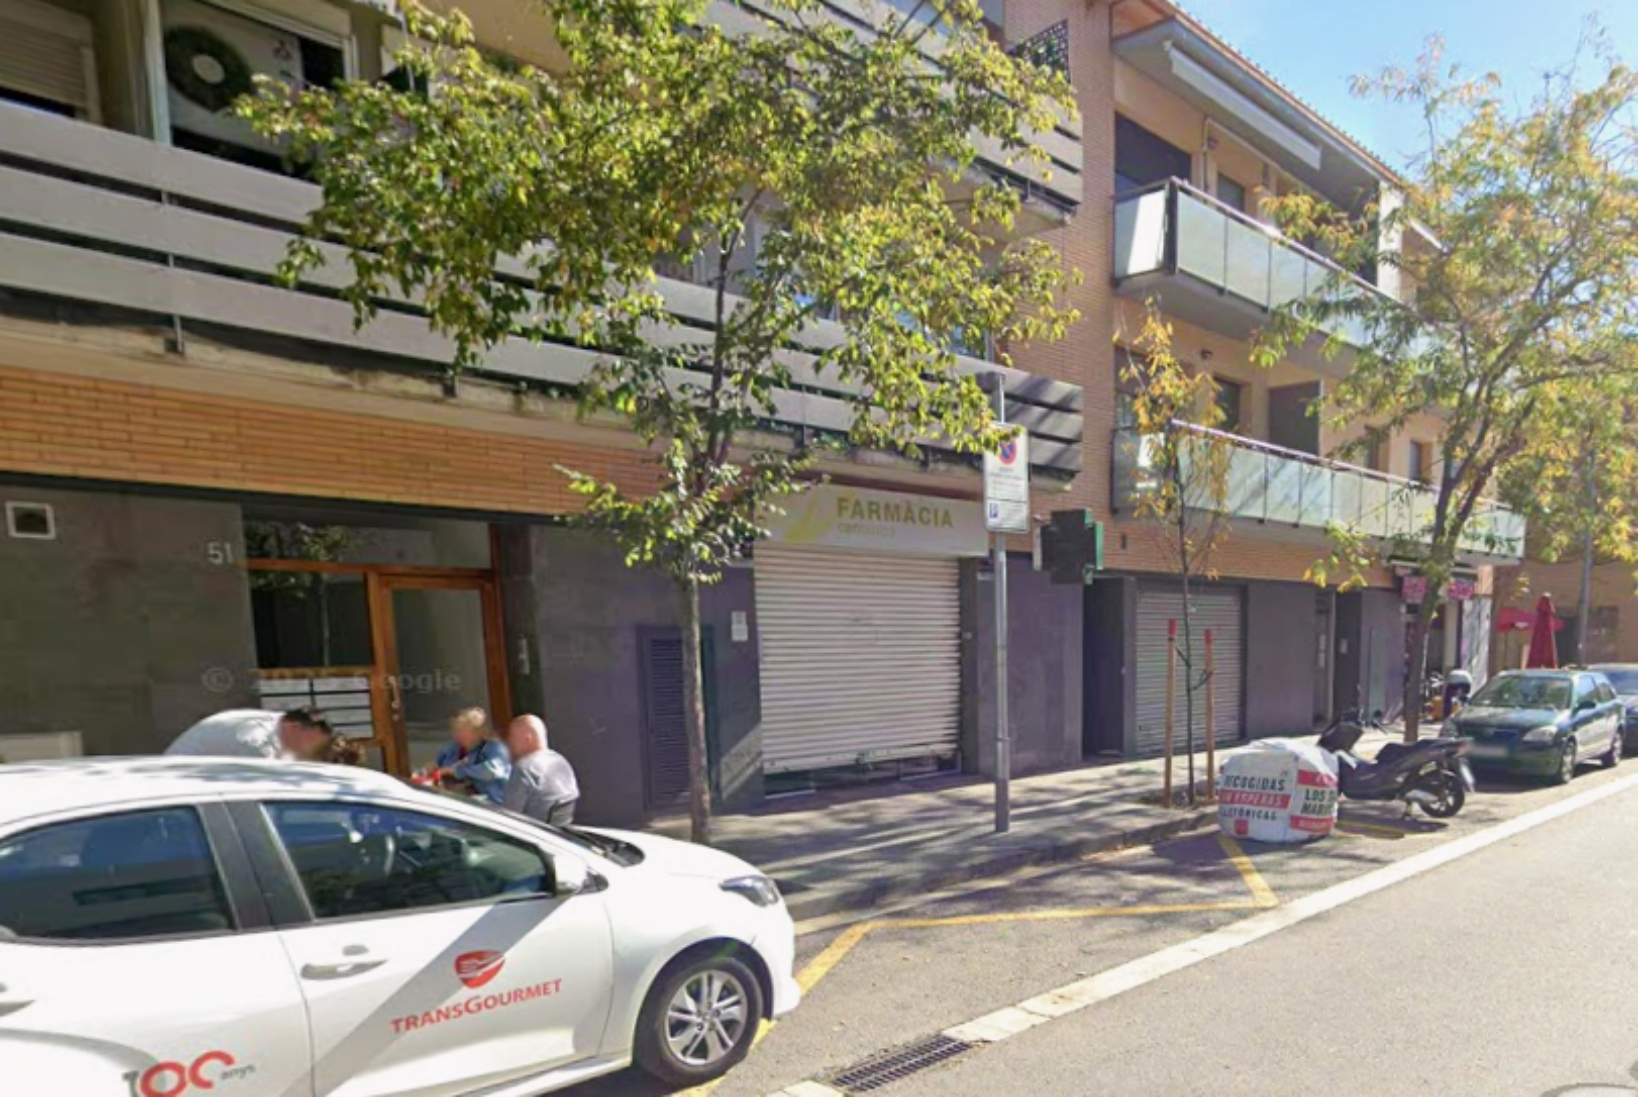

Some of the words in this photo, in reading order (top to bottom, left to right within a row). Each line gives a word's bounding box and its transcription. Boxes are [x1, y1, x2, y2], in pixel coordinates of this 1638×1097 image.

[837, 497, 954, 528] FARMÀCIA
[208, 542, 233, 565] 51
[1221, 774, 1285, 791] ECOGIDAS
[390, 978, 562, 1033] TRANSGOURMET
